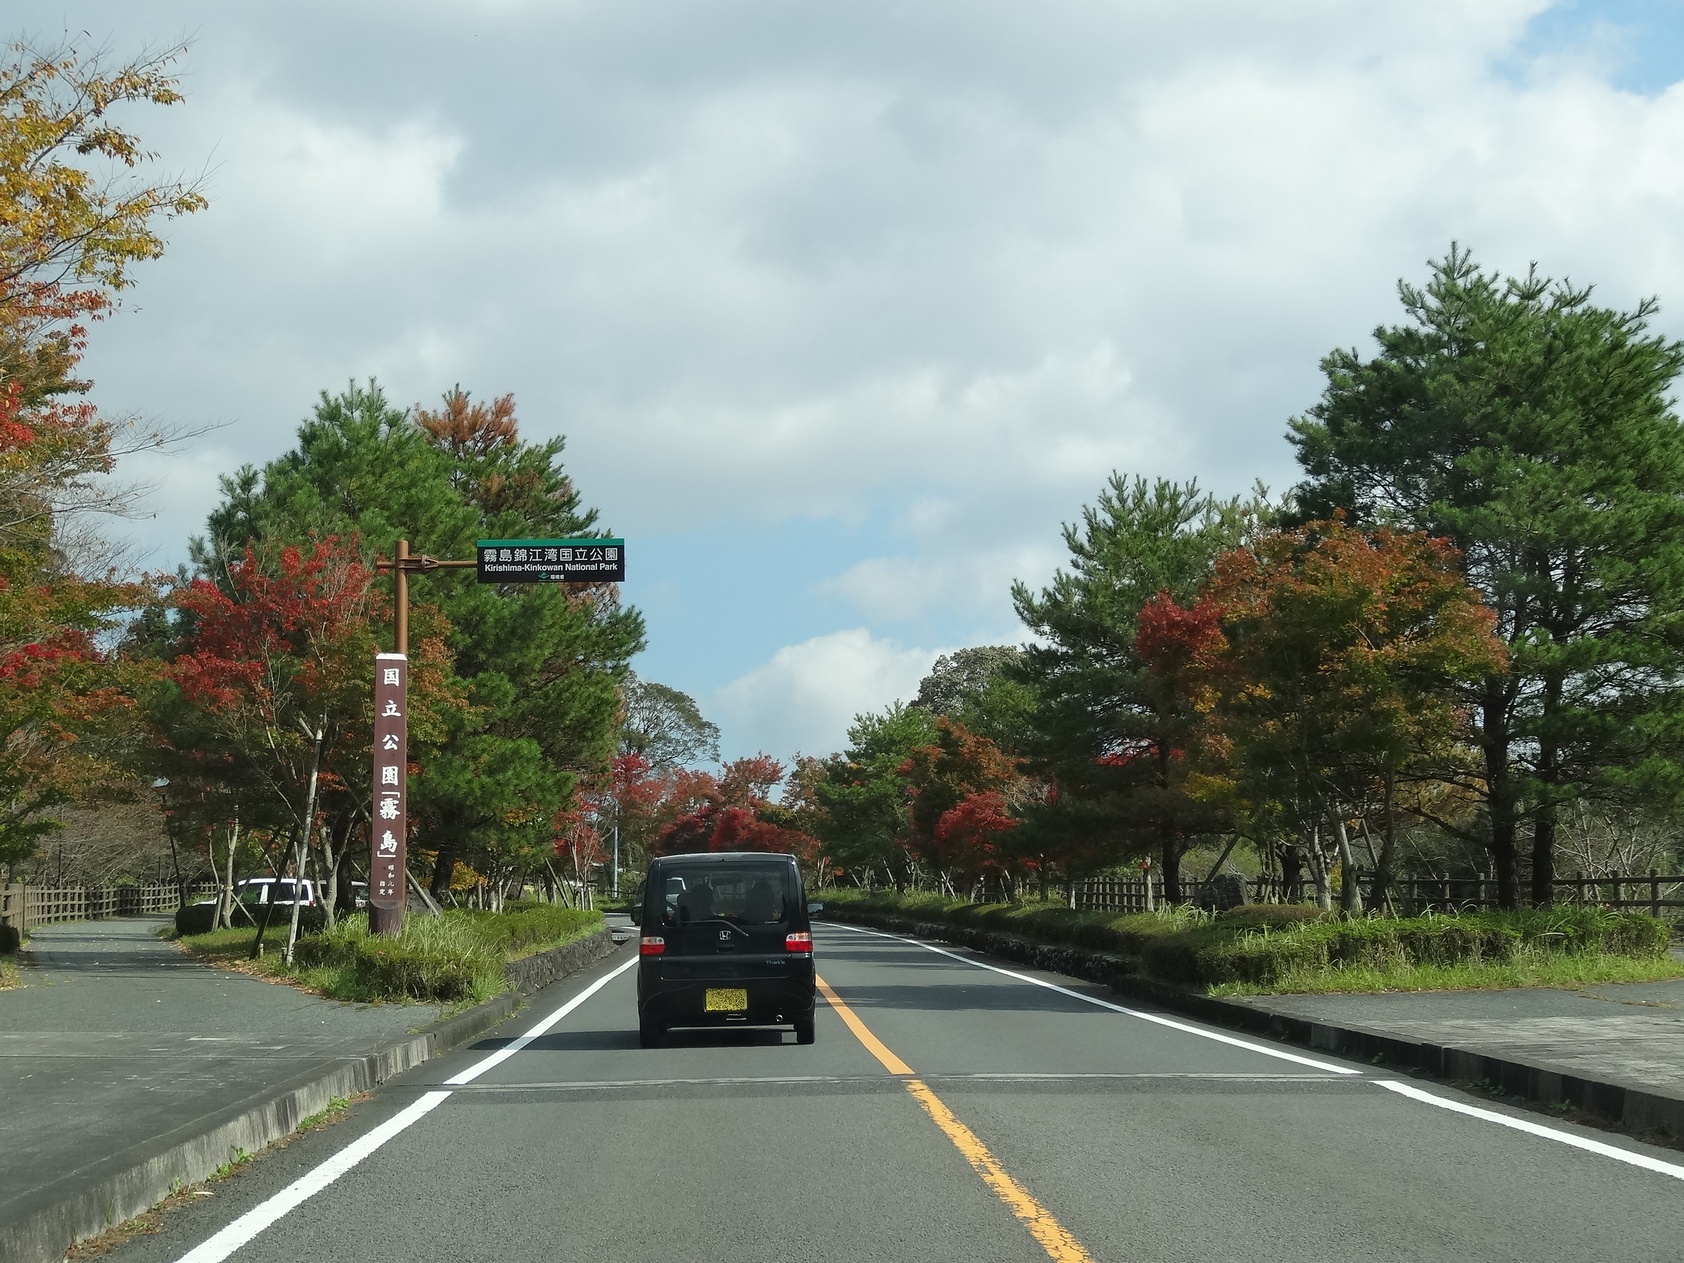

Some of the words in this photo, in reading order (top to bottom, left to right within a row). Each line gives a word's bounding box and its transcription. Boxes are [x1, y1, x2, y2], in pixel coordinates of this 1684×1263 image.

[483, 547, 618, 563] 霧島錦江湾国立公園
[484, 563, 564, 572] Kirishima-Kinkowan
[565, 562, 598, 571] National
[599, 562, 618, 571] Park
